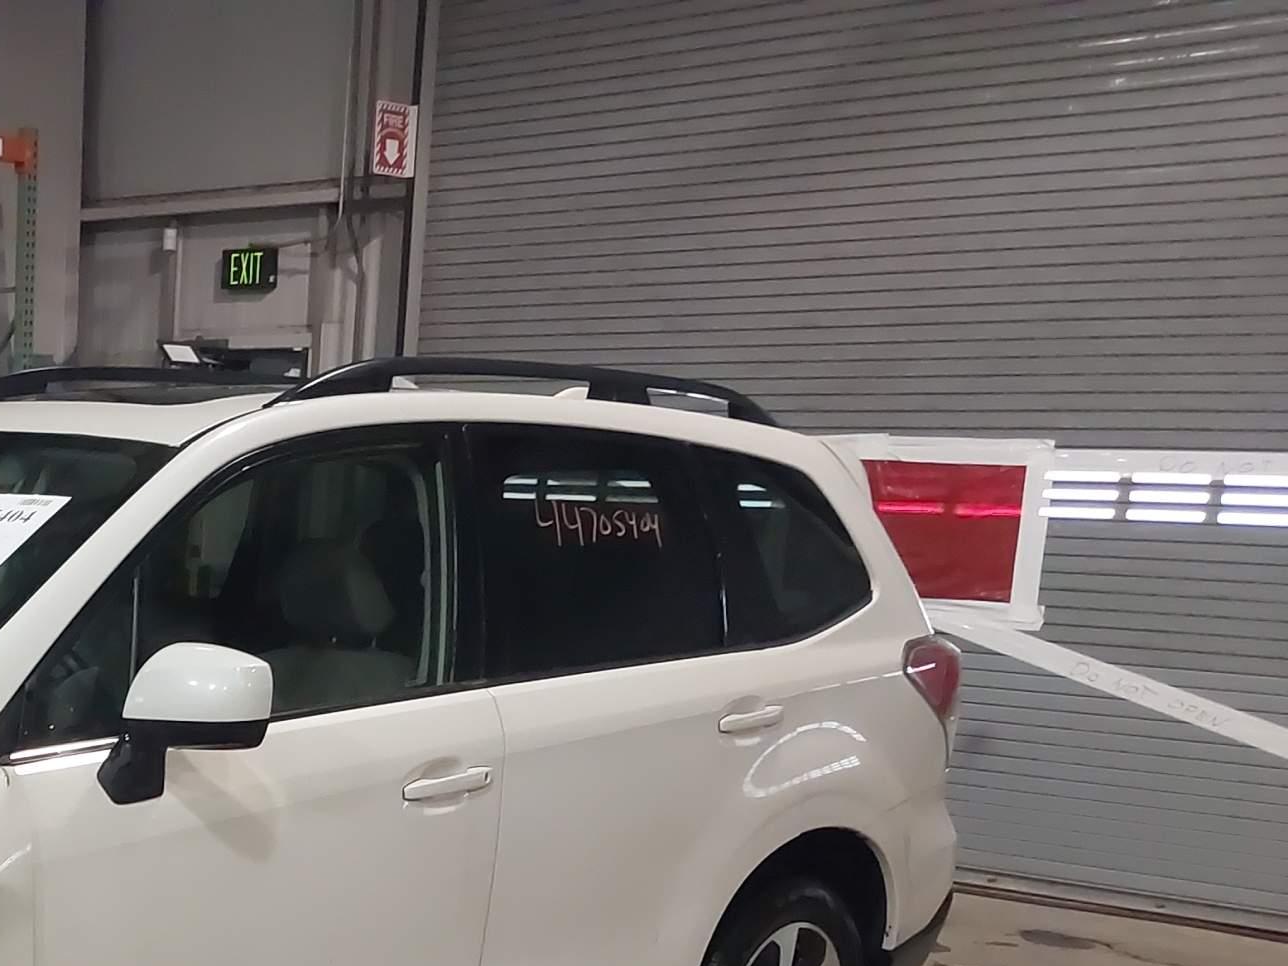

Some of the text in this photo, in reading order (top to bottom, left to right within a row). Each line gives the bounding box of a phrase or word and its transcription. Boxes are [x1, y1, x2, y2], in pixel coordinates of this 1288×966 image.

[383, 113, 404, 128] FIRE
[230, 252, 264, 285] EXIT
[534, 499, 662, 548] 44705404
